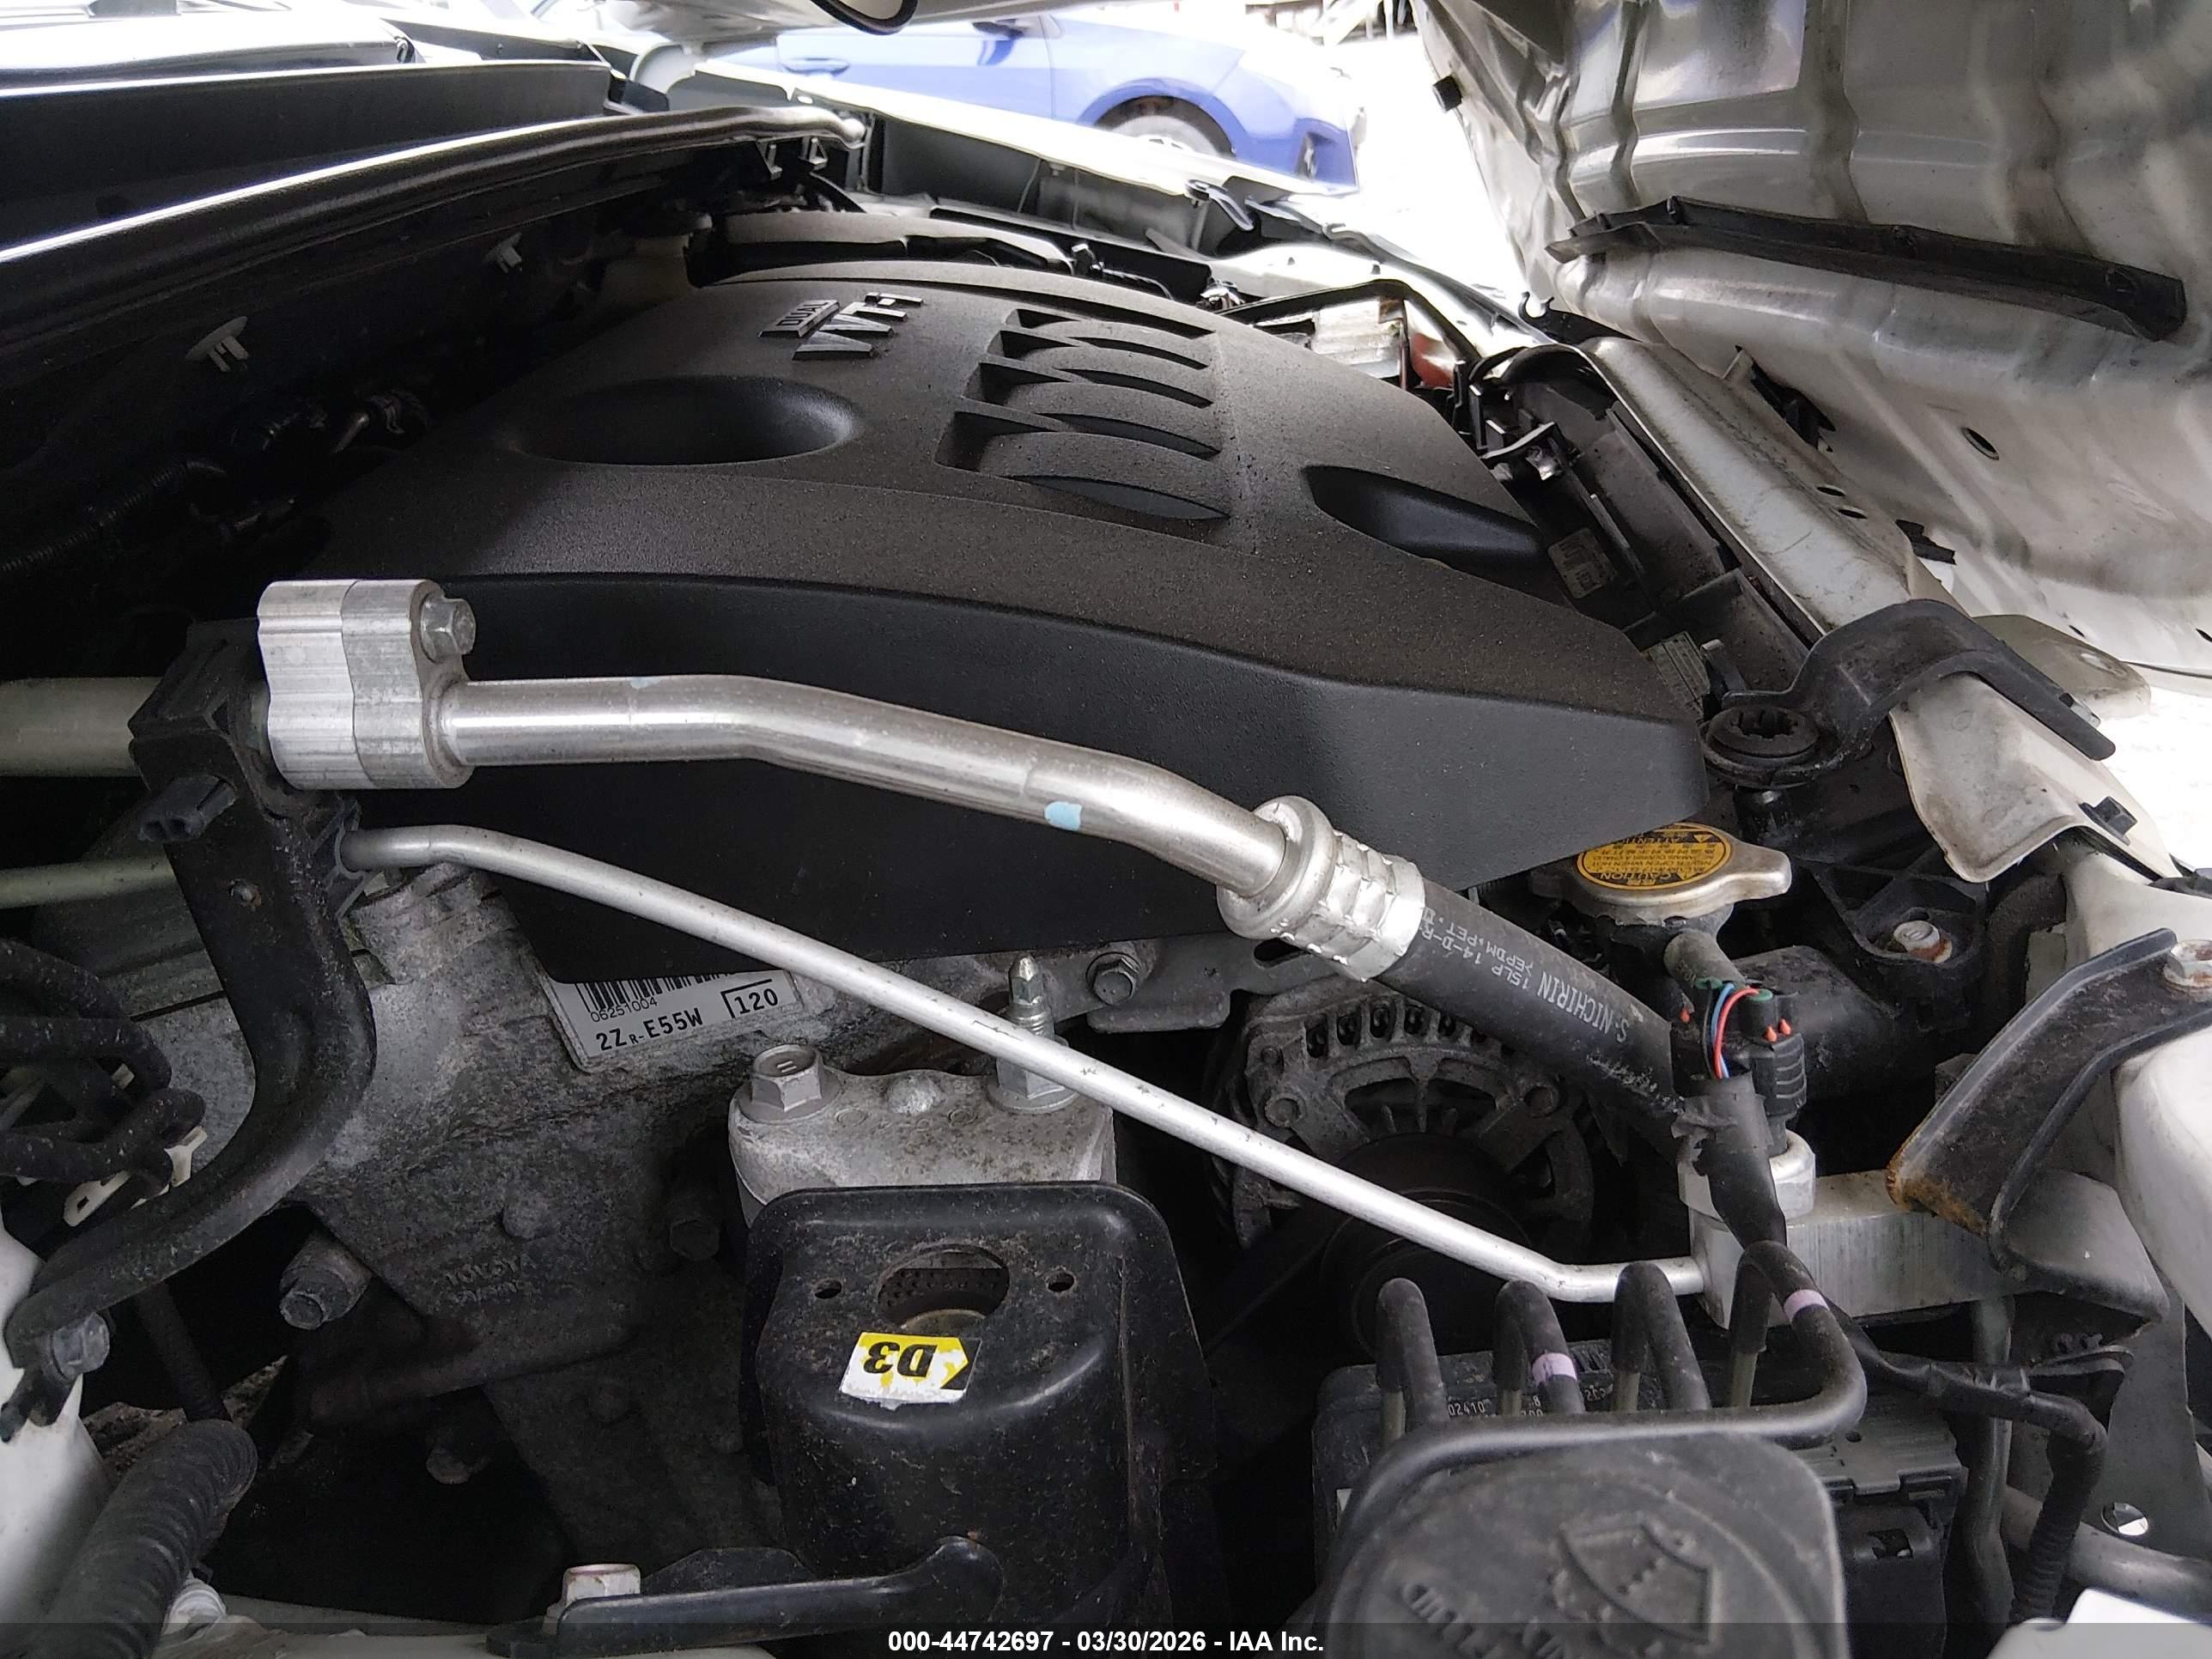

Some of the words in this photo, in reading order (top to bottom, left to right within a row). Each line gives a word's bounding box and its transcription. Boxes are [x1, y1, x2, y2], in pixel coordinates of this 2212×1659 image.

[776, 301, 830, 326] DUAL
[1599, 872, 1672, 881] CAUTION
[590, 996, 659, 1023] 06251004
[733, 988, 780, 1014] 120
[863, 1341, 938, 1377] D3
